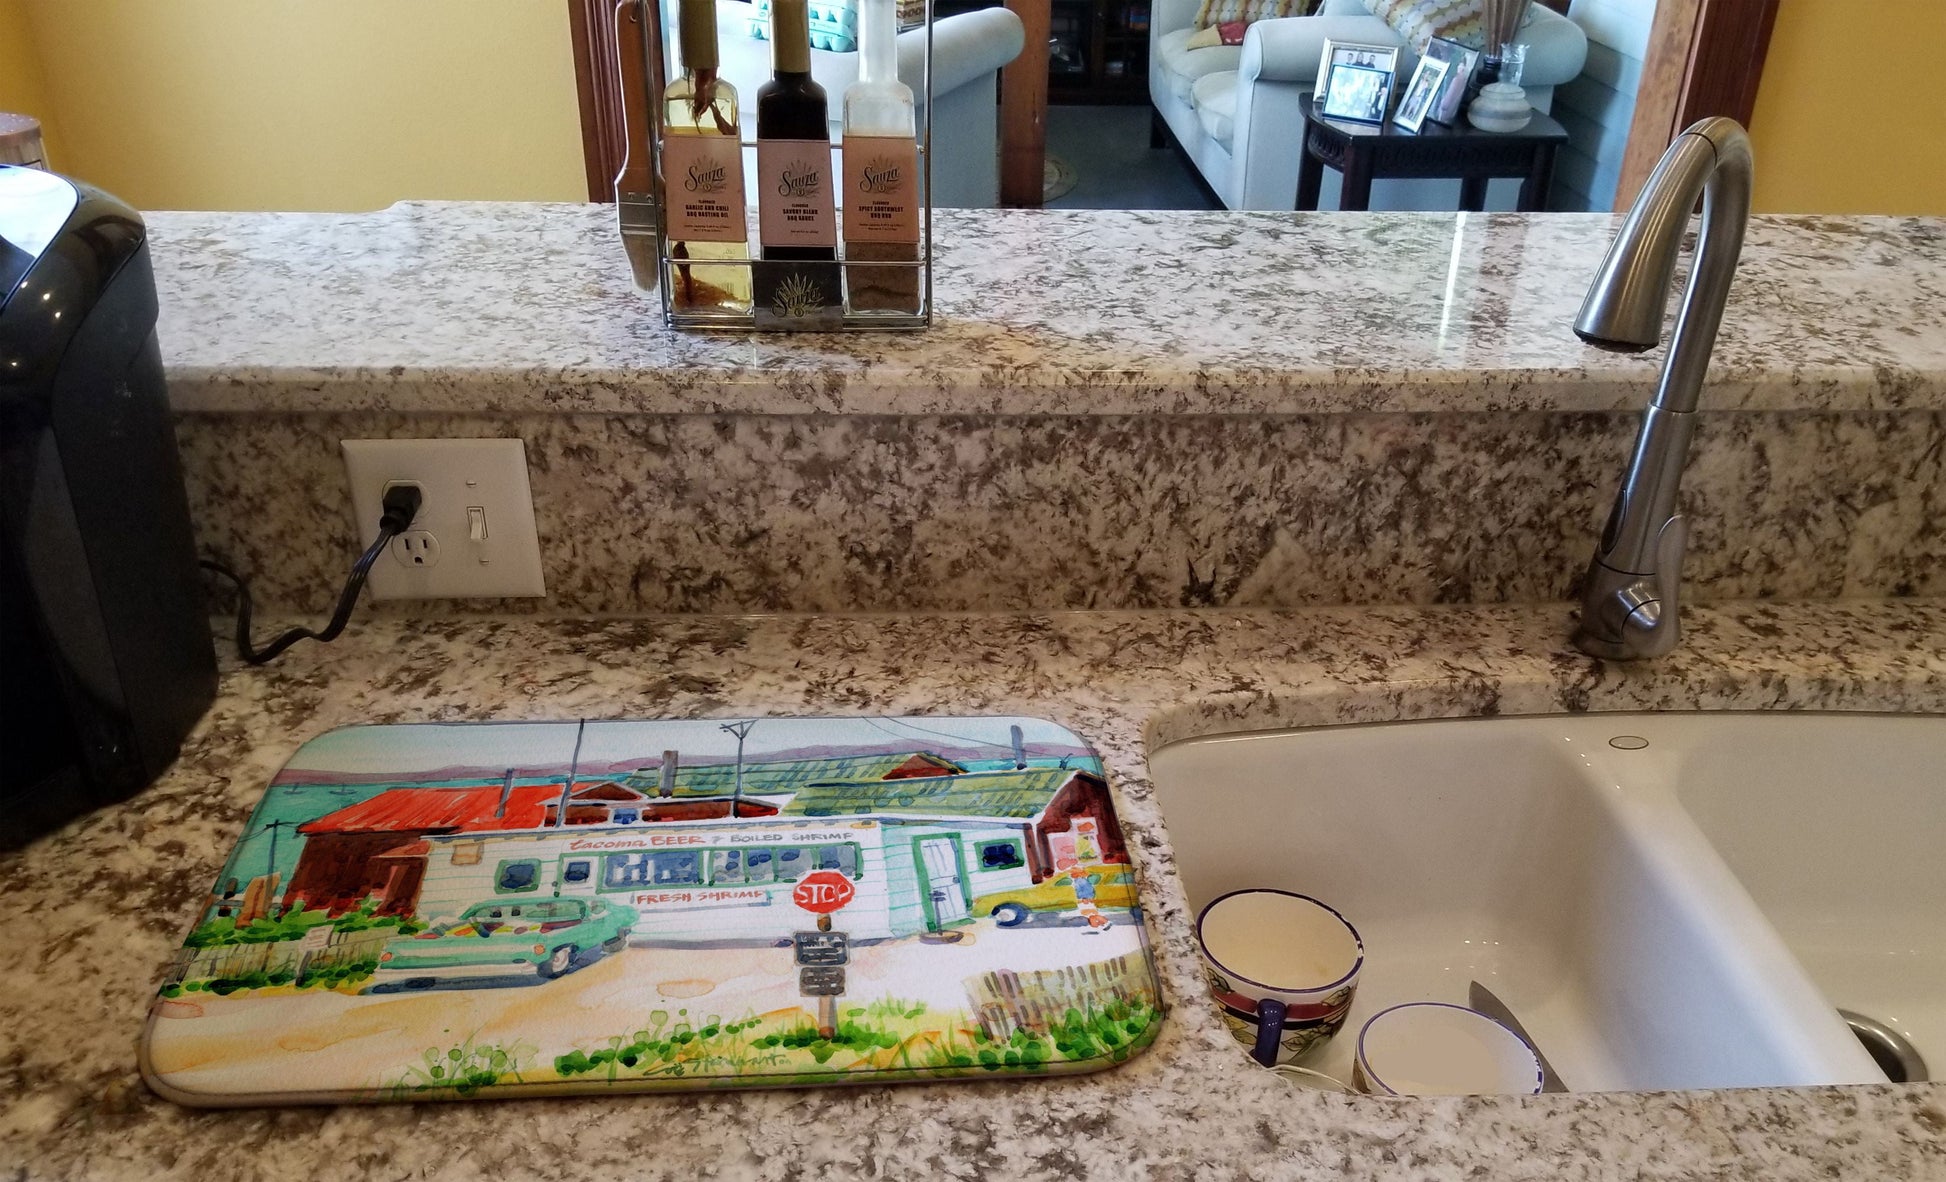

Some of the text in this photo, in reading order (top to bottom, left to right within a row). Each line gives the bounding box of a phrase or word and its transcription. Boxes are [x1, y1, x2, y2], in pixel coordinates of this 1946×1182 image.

[684, 165, 727, 192] Sauza
[778, 170, 820, 197] Sauza
[860, 166, 900, 193] Sauza
[570, 839, 648, 851] tacoma
[650, 835, 706, 847] BEER
[730, 833, 784, 843] BOILED
[792, 832, 854, 841] SHRIMP
[636, 889, 766, 905] FRESH SHRIMP
[796, 882, 852, 905] STOP
